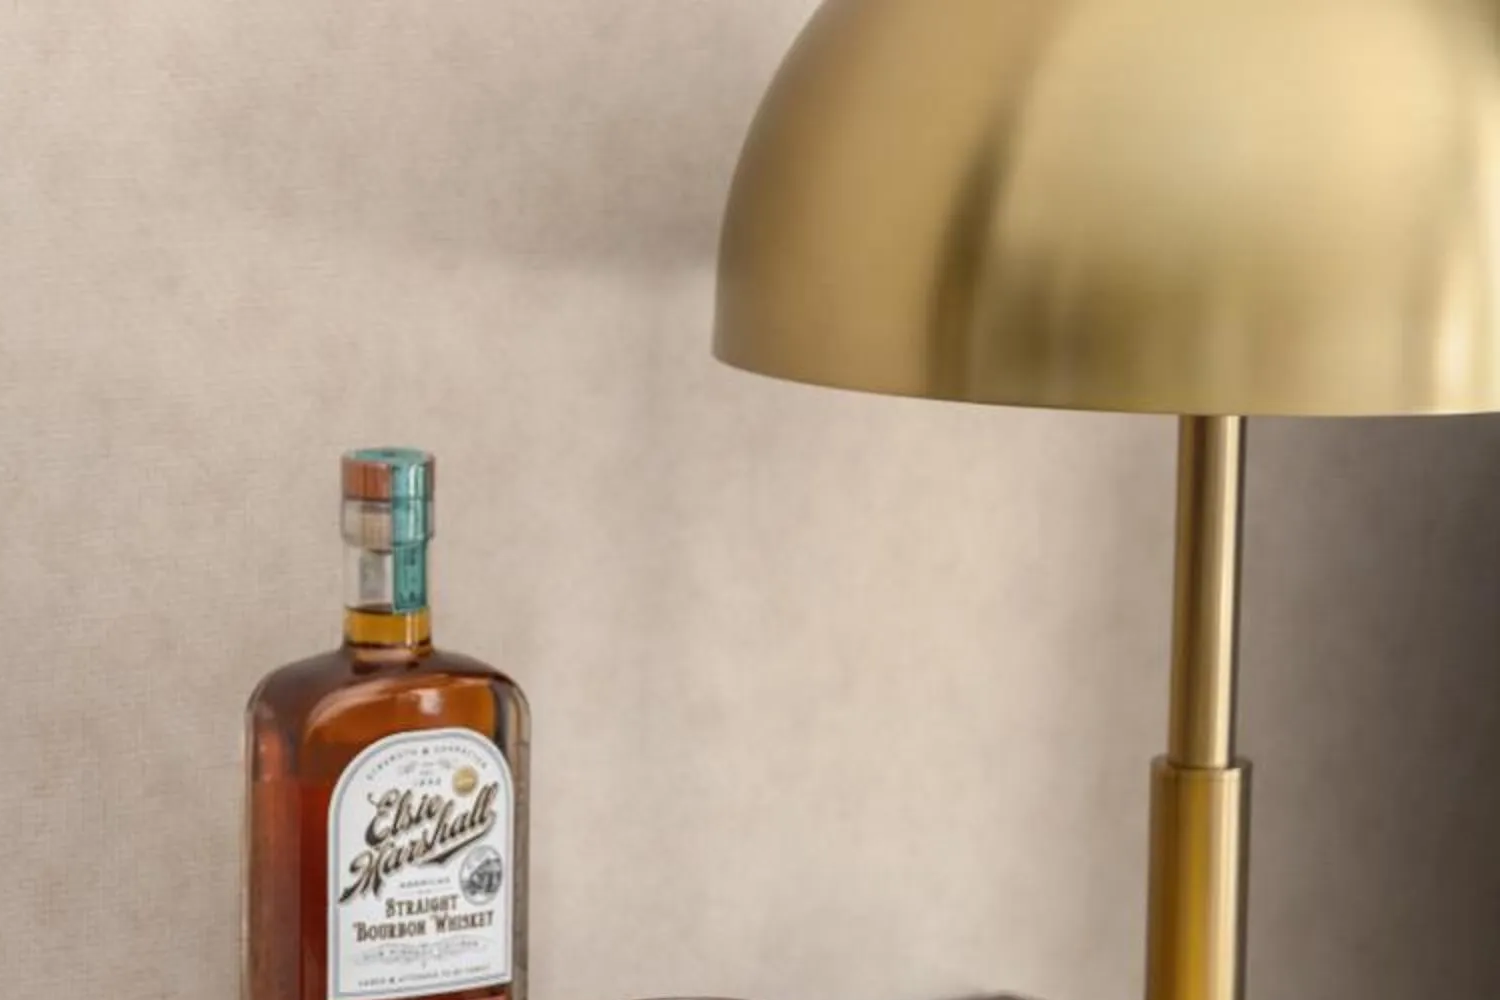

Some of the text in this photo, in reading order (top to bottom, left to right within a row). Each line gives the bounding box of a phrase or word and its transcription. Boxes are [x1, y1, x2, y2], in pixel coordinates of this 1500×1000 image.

[365, 788, 443, 846] Elsie
[339, 782, 498, 903] Marshall
[353, 909, 494, 942] BOURBON WHISKEY
[385, 894, 458, 918] STRAIGHT
